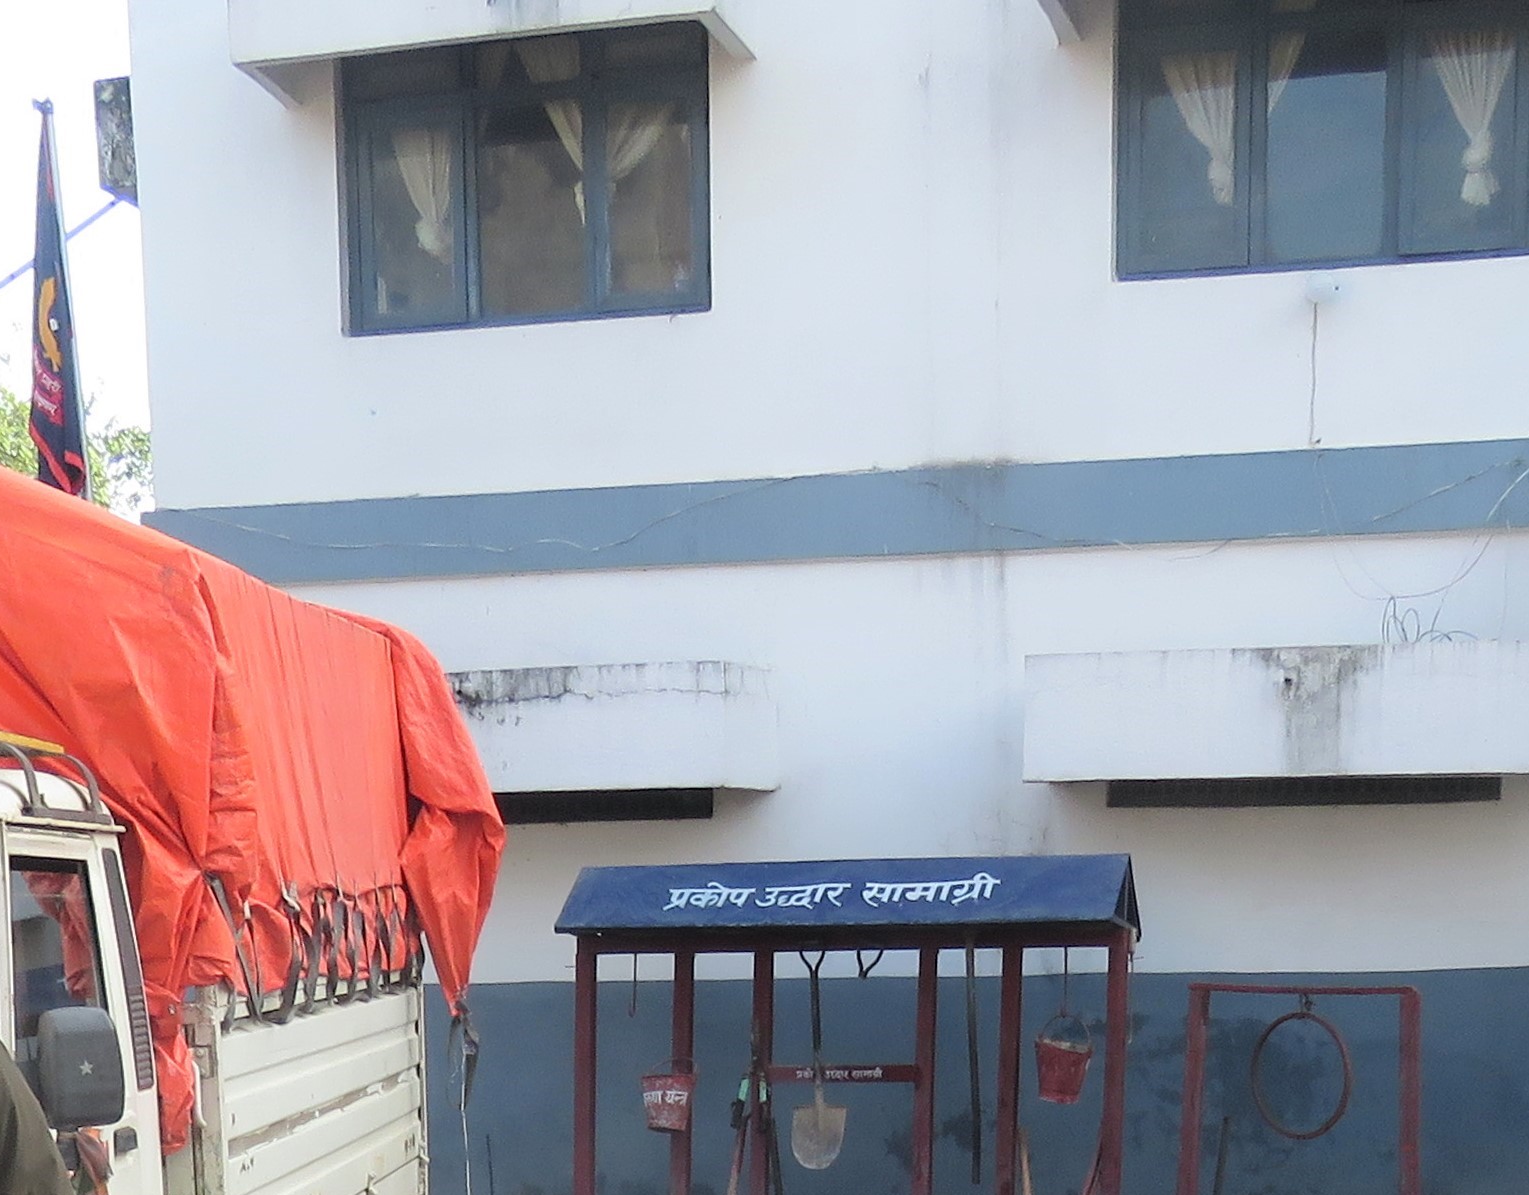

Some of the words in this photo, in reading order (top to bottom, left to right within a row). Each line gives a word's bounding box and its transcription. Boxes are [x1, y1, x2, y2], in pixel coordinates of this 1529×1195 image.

[662, 882, 756, 911] प्रकोप
[863, 872, 1001, 907] सामाग्री
[795, 1067, 814, 1080] प्रको
